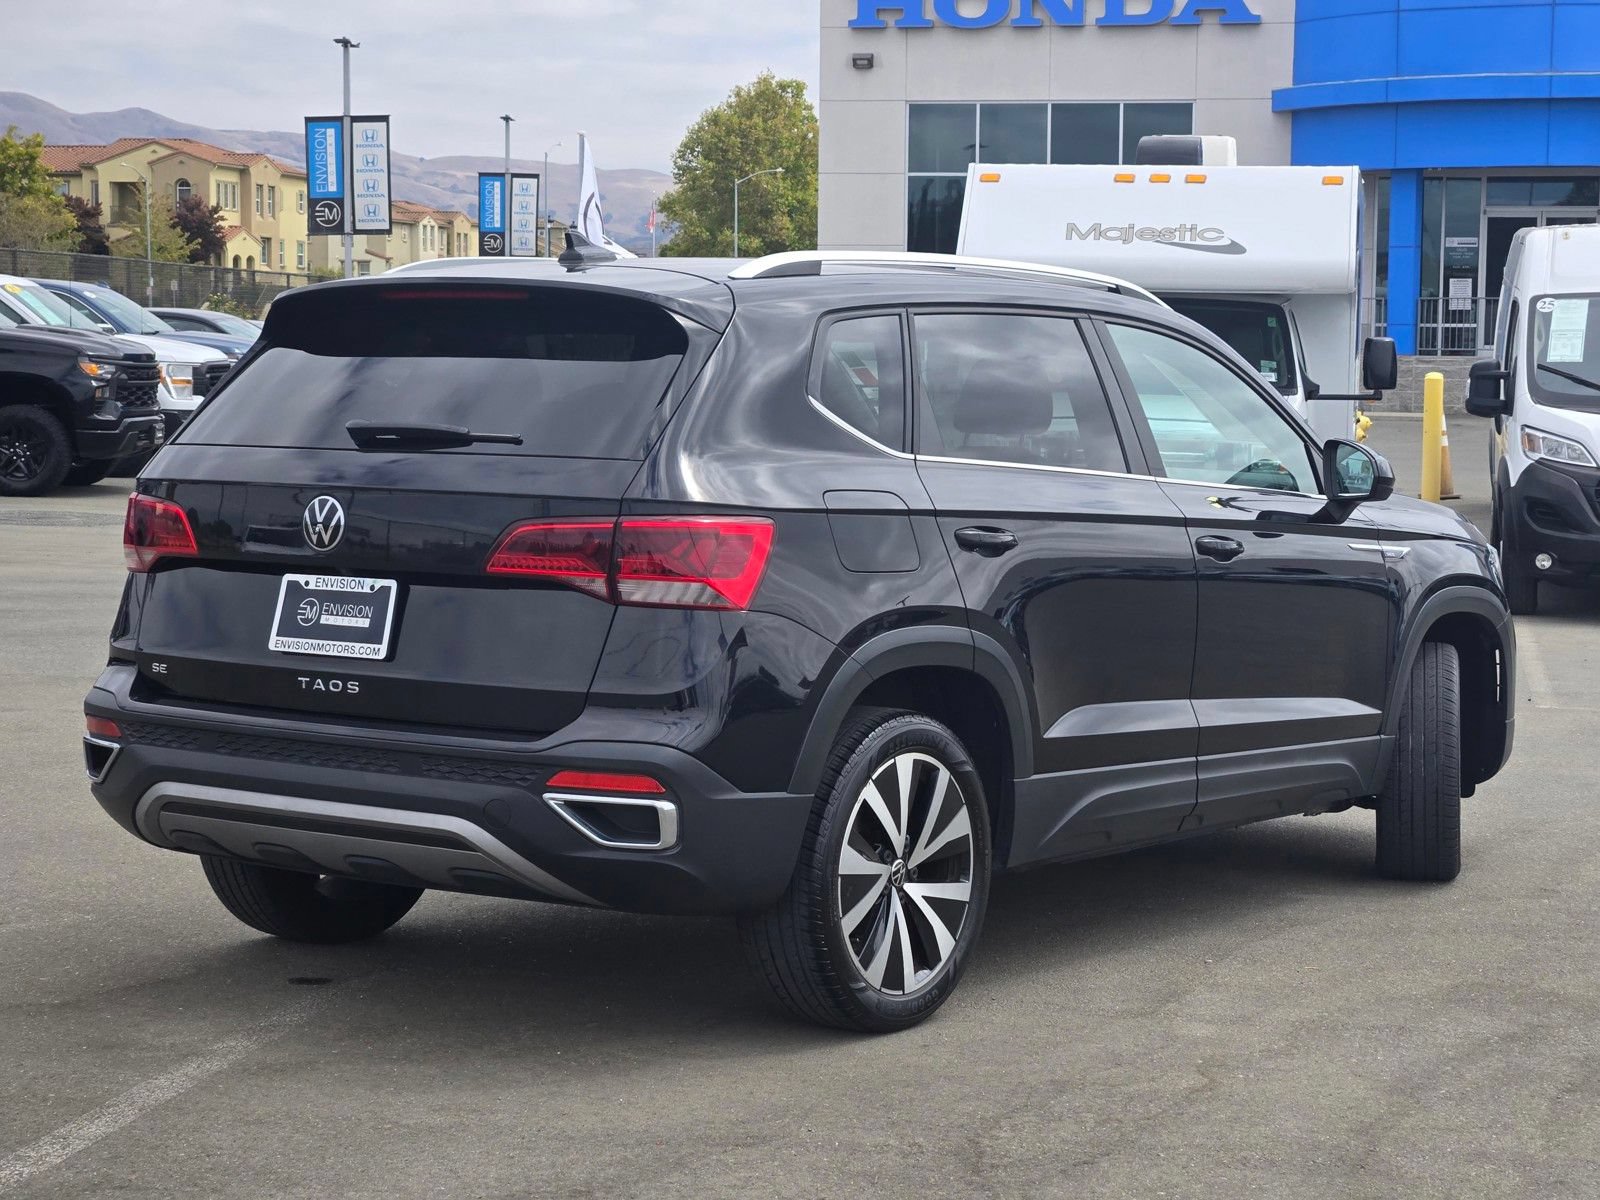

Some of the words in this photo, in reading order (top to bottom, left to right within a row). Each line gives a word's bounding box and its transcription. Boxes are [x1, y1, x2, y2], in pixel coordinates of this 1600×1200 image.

[314, 128, 327, 192] ENVISION
[485, 181, 494, 228] ENVISION
[1065, 222, 1224, 245] Majestic
[1539, 300, 1555, 310] 25
[315, 577, 365, 590] ENVISION
[321, 603, 373, 617] ENVISION
[324, 617, 366, 626] MOTORS
[275, 639, 380, 656] ENVISIONMOTORS.COM
[152, 663, 168, 673] SE
[298, 677, 360, 693] TAOS
